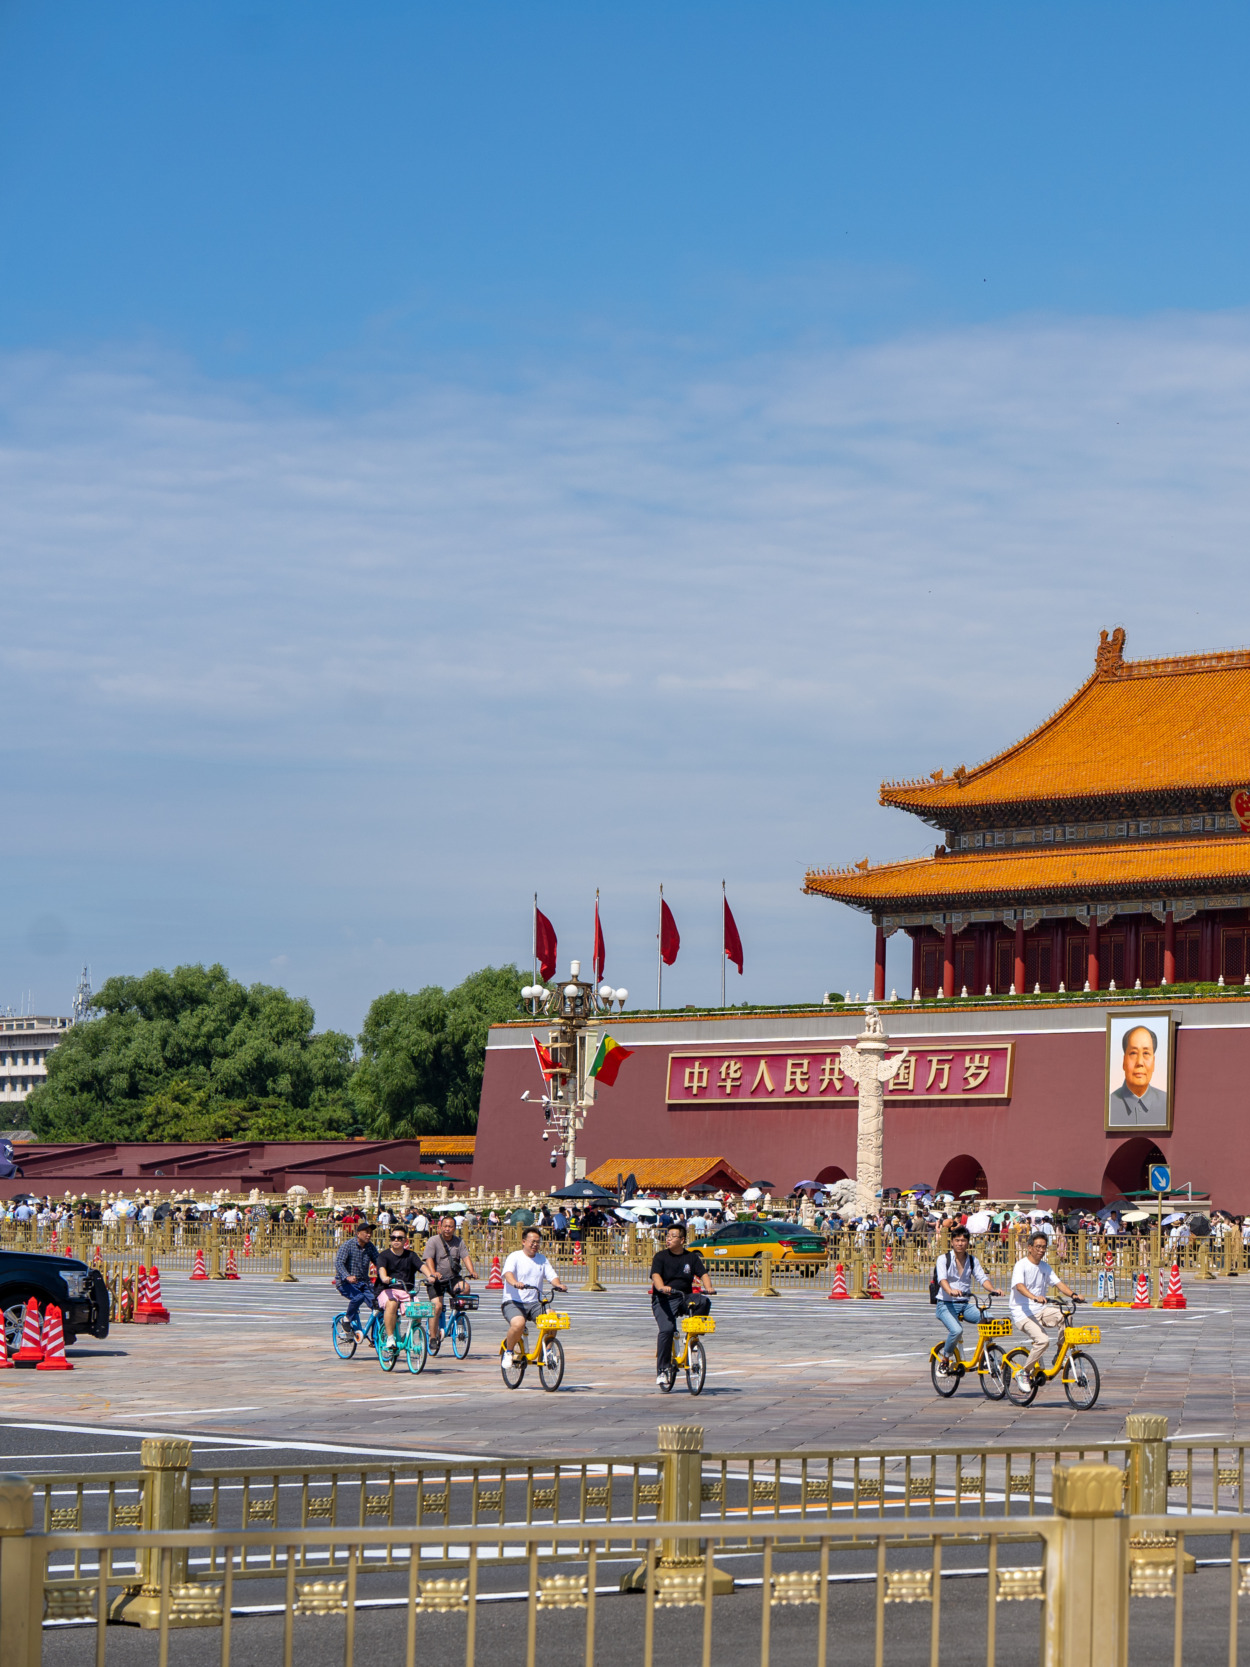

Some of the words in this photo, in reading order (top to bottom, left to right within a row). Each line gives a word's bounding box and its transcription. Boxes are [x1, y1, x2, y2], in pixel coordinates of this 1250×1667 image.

[684, 1053, 991, 1095] 中华人民共国万岁
